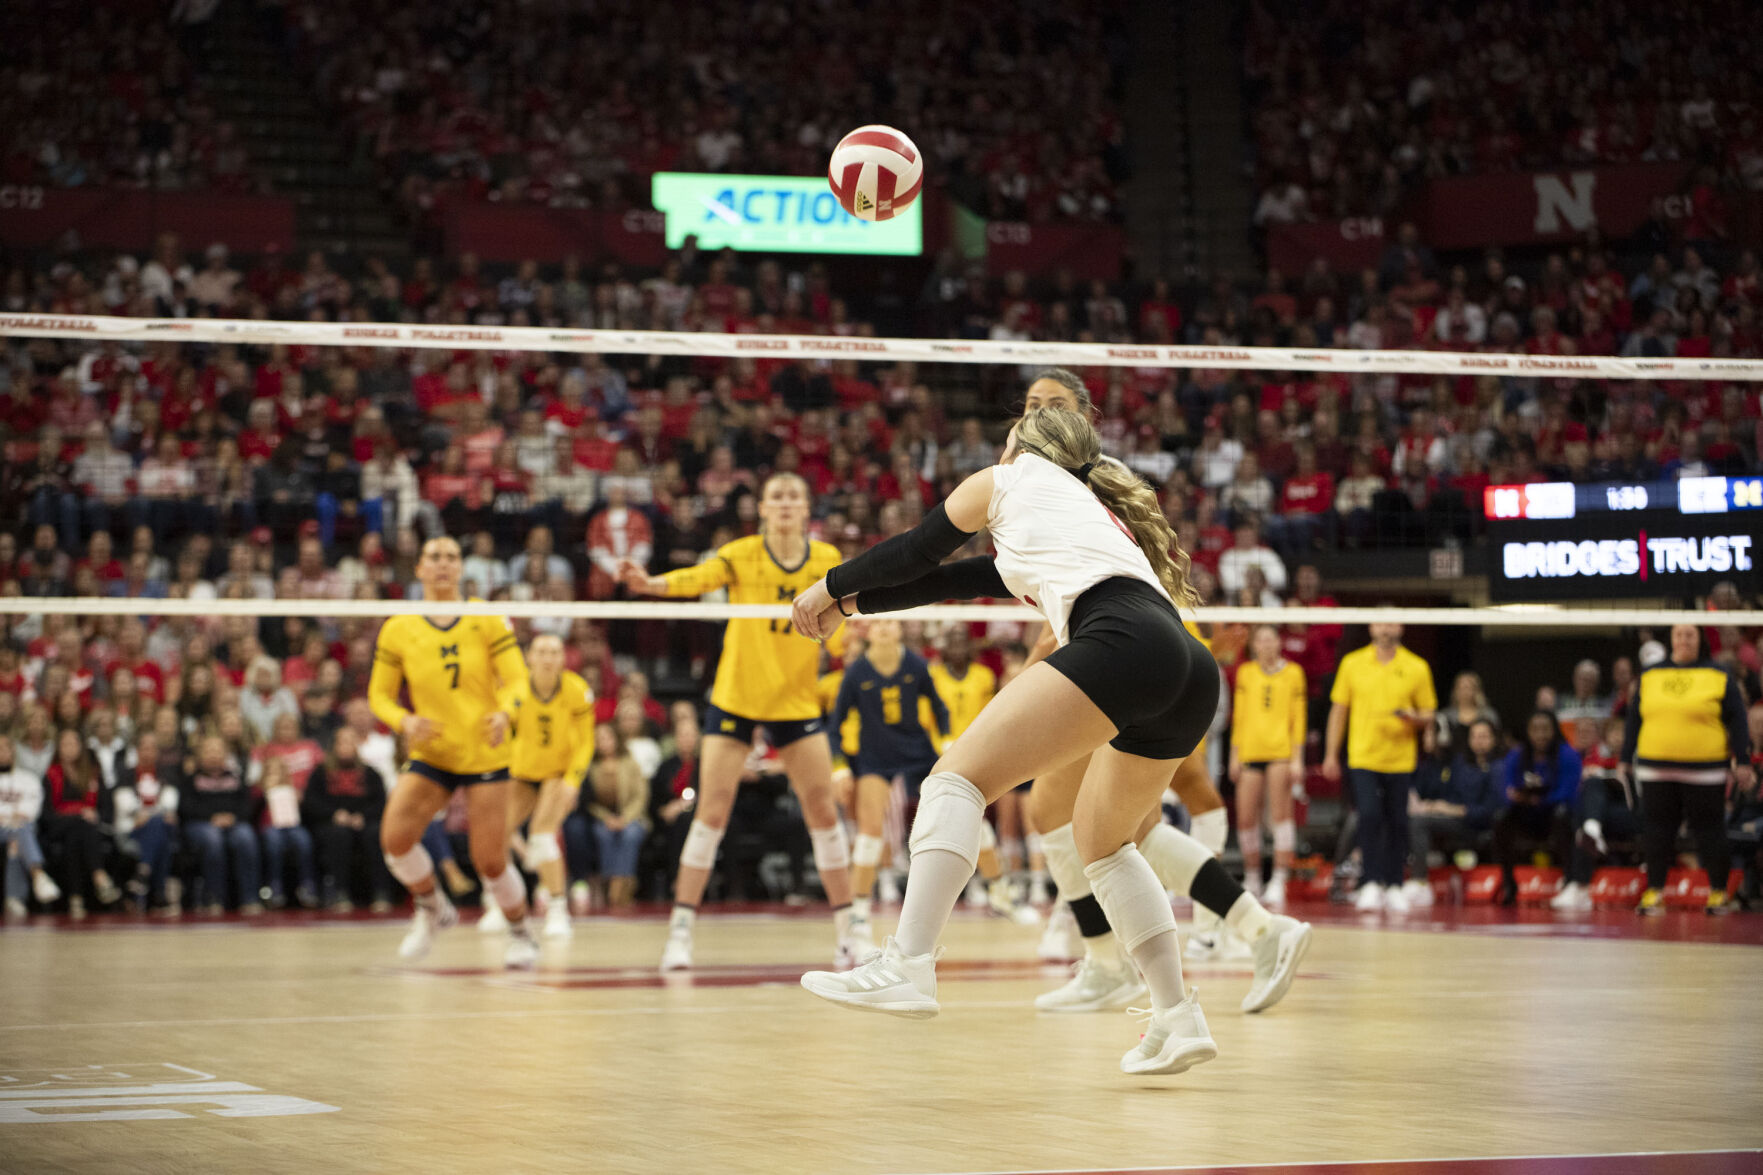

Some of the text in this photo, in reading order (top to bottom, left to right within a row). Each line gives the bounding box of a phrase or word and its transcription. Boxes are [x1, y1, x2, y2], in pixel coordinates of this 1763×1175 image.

[705, 190, 869, 225] ACTIO
[1534, 172, 1596, 233] N
[444, 662, 460, 690] 7
